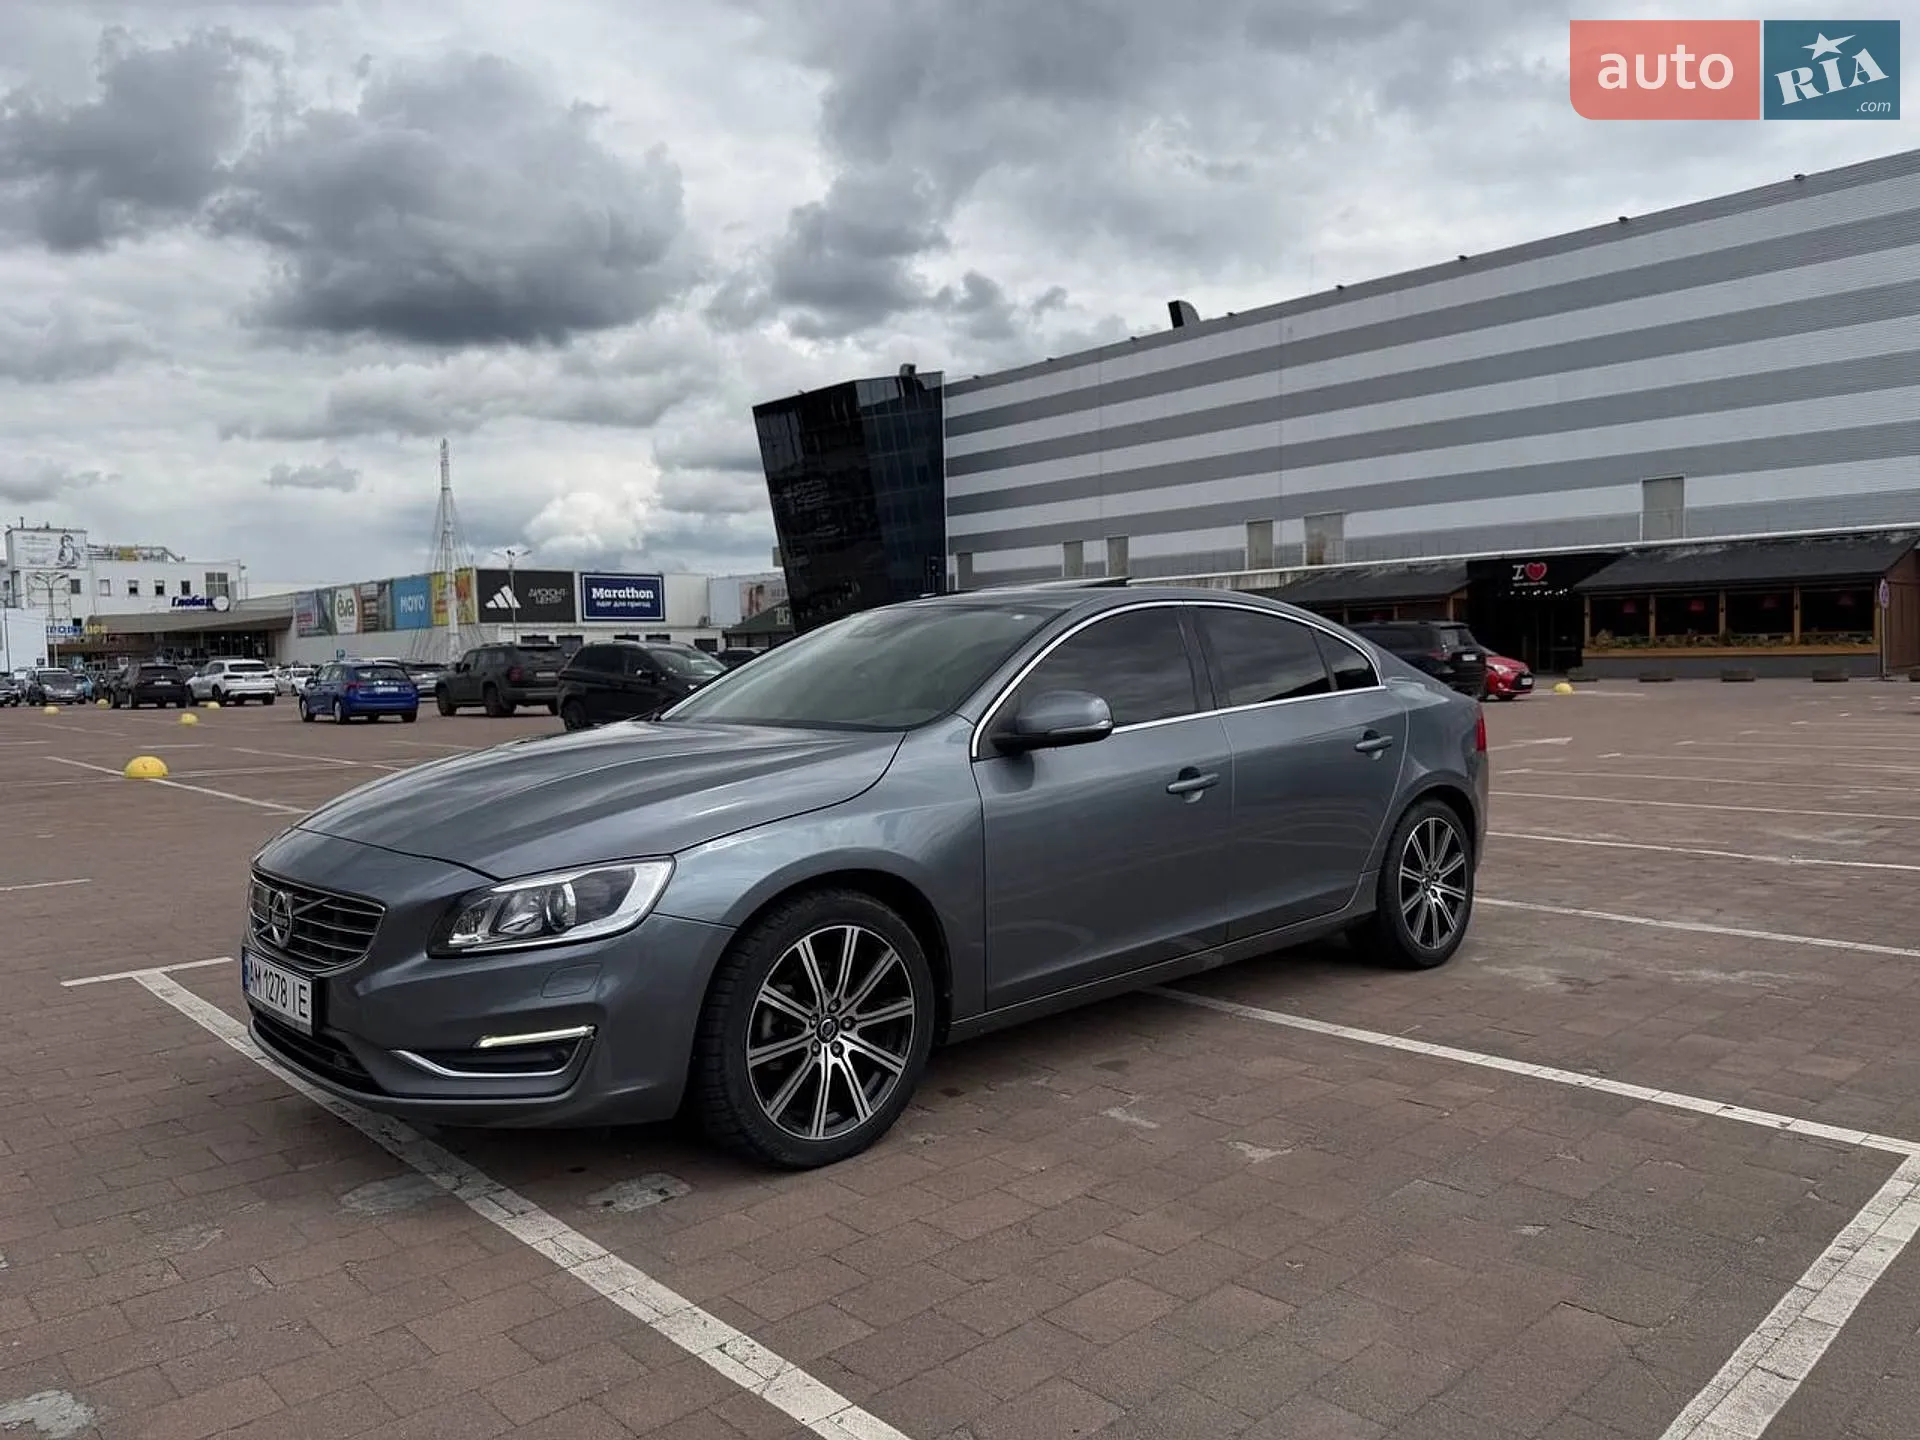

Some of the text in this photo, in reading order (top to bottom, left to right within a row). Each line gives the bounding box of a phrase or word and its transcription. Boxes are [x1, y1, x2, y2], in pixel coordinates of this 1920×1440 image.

[592, 587, 654, 599] Marathon
[400, 595, 426, 613] MOYO
[249, 958, 308, 1018] AM 1278 IE
